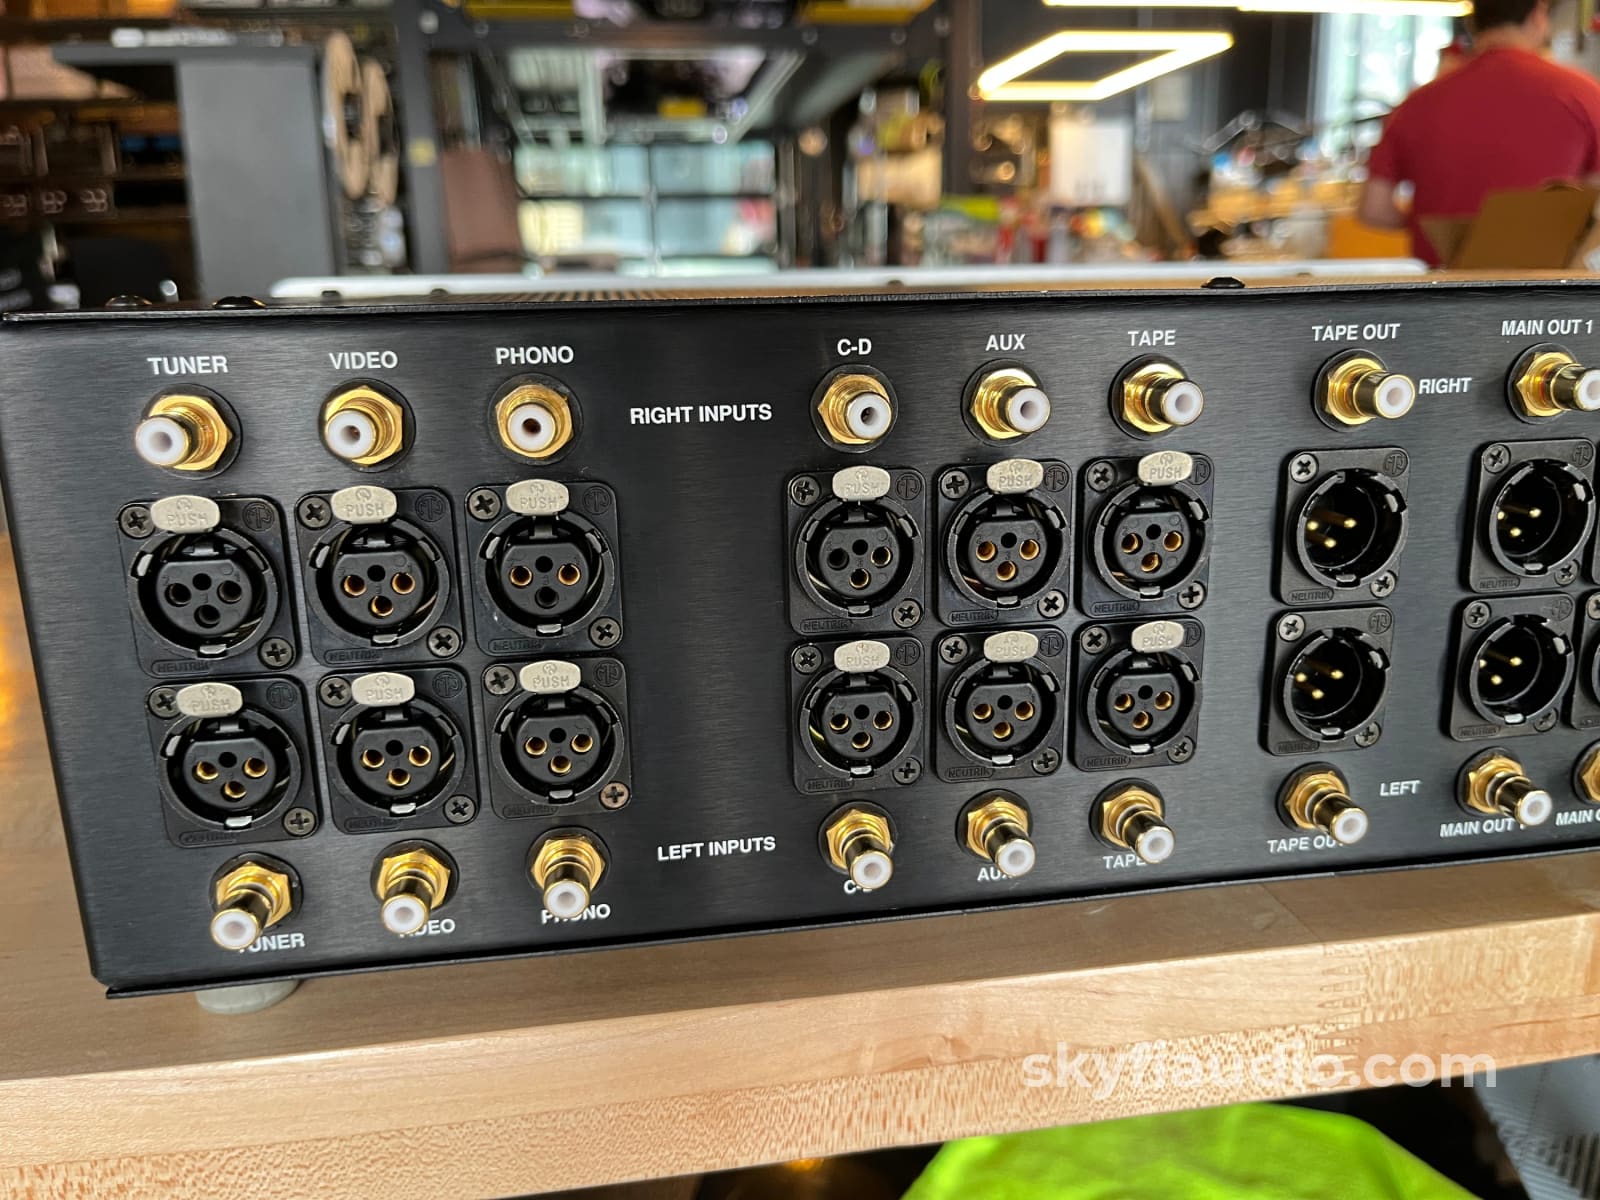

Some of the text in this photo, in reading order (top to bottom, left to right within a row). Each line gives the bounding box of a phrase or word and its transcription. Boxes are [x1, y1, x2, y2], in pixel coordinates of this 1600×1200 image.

[1311, 323, 1400, 342] TAPE OUT
[1501, 319, 1593, 336] MAIN OUT 1
[836, 338, 873, 356] C-D
[984, 333, 1026, 351] AUX
[1127, 329, 1177, 347] TAPE
[328, 350, 399, 370] VIDEO
[495, 345, 575, 365] PHONO
[147, 355, 229, 376] TUNER
[1418, 376, 1472, 395] RIGHT
[629, 403, 773, 425] RIGHT INPUTS
[1151, 466, 1182, 479] PUSH
[345, 502, 385, 517] PUSH
[532, 675, 570, 688] PUSH
[1380, 780, 1420, 797] LEFT
[1439, 822, 1481, 837] MAIN
[1482, 817, 1516, 834] OUT
[1555, 809, 1594, 826] MAIN
[657, 836, 776, 861] LEFT INPUTS
[1267, 834, 1344, 853] TAPE OU
[977, 866, 1012, 882] AU
[541, 903, 611, 924] PNO
[239, 932, 306, 953] UNER
